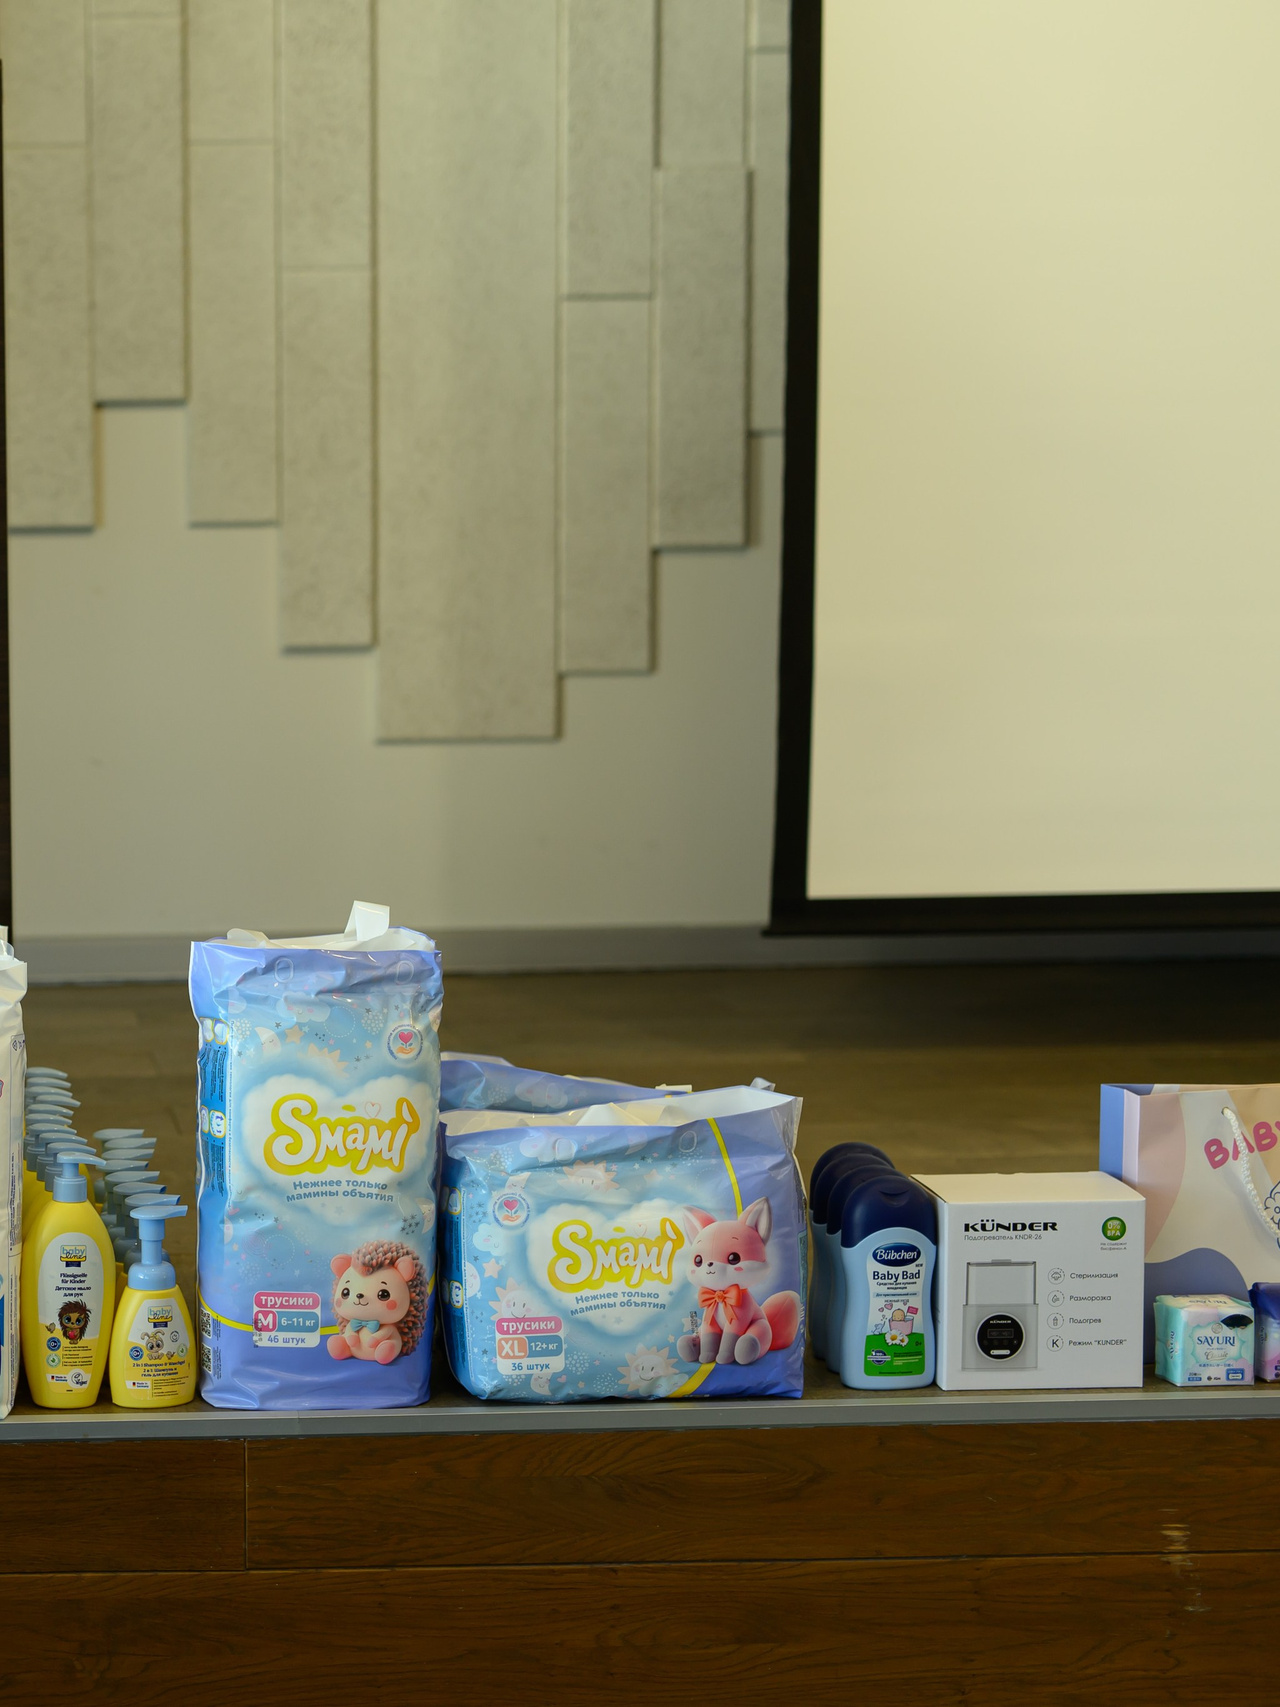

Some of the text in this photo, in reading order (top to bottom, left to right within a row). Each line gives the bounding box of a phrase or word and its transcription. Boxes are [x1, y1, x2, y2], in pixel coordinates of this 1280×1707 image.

[1204, 1121, 1280, 1169] BAB
[292, 1179, 388, 1191] Нежнее только
[285, 1189, 394, 1203] мамины объятия
[963, 1218, 1059, 1233] KÜNDER
[1107, 1221, 1121, 1230] 0%
[963, 1234, 1014, 1242] Подогреватель
[62, 1247, 86, 1256] baby
[875, 1249, 918, 1260] Bübchen
[872, 1269, 921, 1283] Baby Bad
[1070, 1271, 1119, 1280] Стерилизация
[260, 1295, 313, 1307] трусики
[575, 1289, 660, 1304] Нежнее только
[1069, 1295, 1112, 1303] Разморозка
[149, 1307, 171, 1316] baby
[570, 1300, 666, 1317] мамины объятия
[257, 1313, 315, 1329] M 6-11 кг
[501, 1319, 556, 1333] трусики
[1069, 1317, 1102, 1326] Подогрев
[267, 1335, 306, 1345] 46 штук
[1196, 1335, 1236, 1347] SAYURI
[501, 1339, 558, 1356] XL 12+ кг
[511, 1361, 551, 1373] 36 штук
